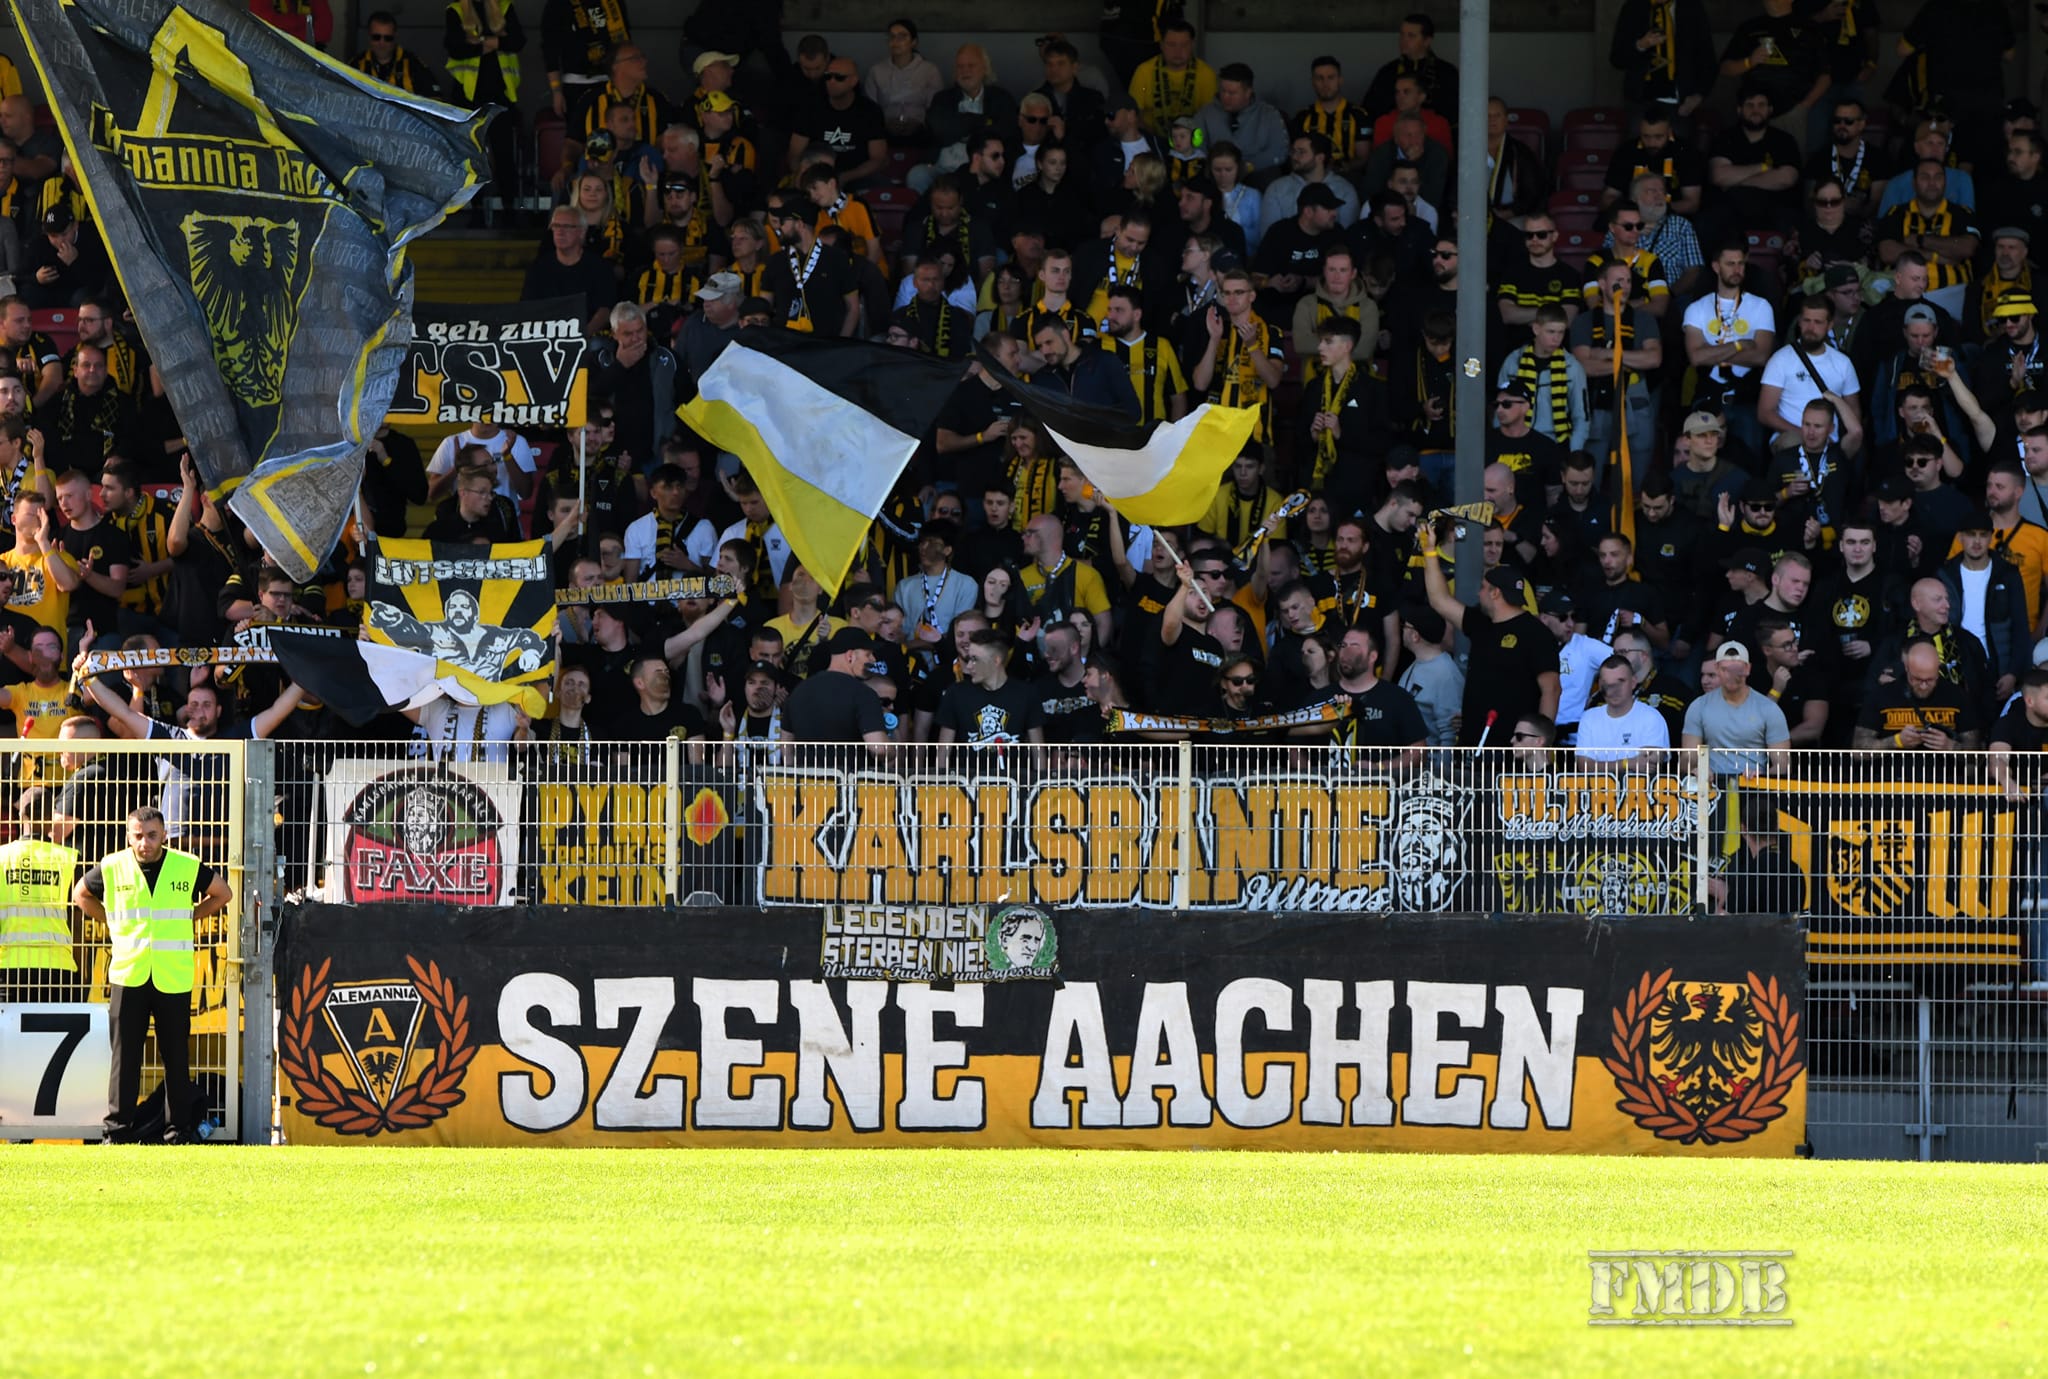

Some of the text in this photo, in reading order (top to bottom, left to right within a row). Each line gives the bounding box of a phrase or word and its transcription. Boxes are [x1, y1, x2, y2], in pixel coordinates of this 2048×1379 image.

[427, 320, 490, 346] geh
[499, 318, 582, 341] zum
[388, 338, 587, 412] TSV
[374, 553, 548, 587] LUTSCHER!
[87, 648, 279, 674] KARLS BAN
[538, 783, 683, 845] PYRO
[1498, 774, 1684, 823] ULTRAS
[758, 776, 1397, 907] KARLSBANDE
[170, 881, 190, 893] 148
[356, 847, 492, 893] FAXE
[541, 865, 682, 906] KEIN
[1247, 872, 1391, 911] Ultras
[825, 904, 986, 939] LEGENDEN
[822, 961, 885, 979] Werner
[888, 963, 938, 982] Fuchs
[823, 936, 986, 973] STERBEN NIE!
[327, 987, 419, 1005] ALEMANNIA
[364, 1007, 397, 1043] A
[20, 1012, 91, 1117] 7
[496, 972, 1585, 1133] SZENE AACHEN
